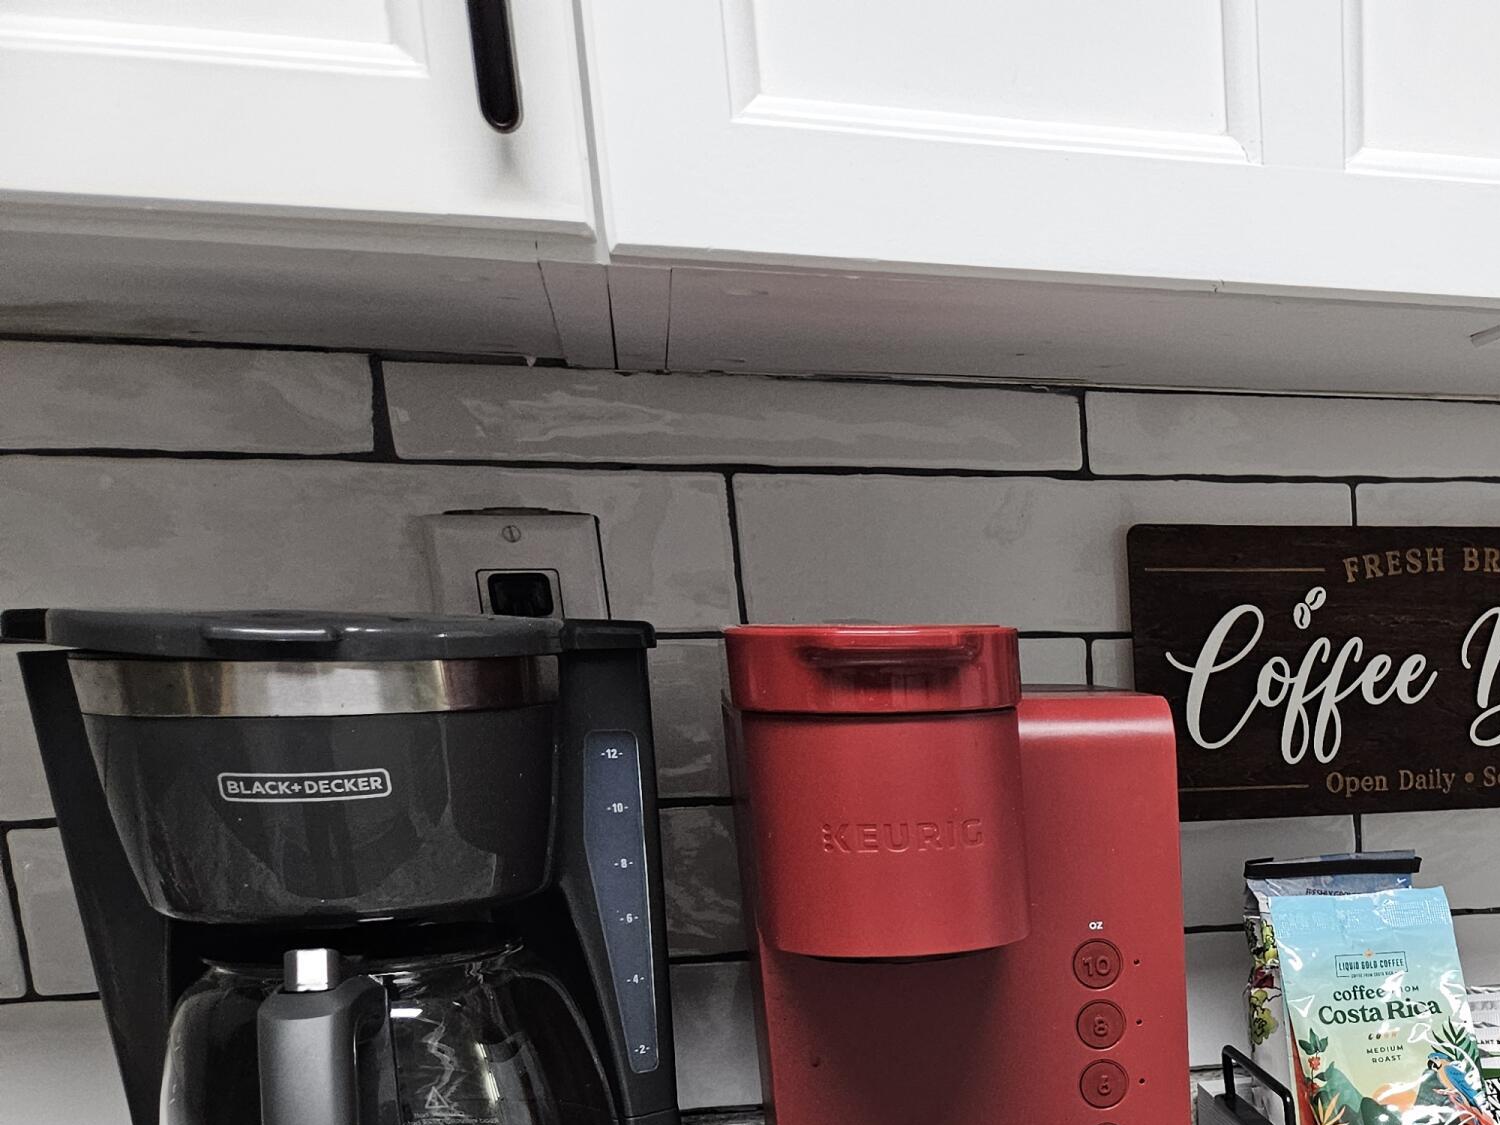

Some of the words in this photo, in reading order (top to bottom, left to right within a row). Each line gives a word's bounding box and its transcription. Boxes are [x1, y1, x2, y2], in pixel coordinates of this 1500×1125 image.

[1342, 547, 1446, 583] FRESH
[1165, 603, 1439, 765] Coffee
[226, 776, 384, 795] BLACK+DECKER
[1326, 771, 1389, 797] Open
[1399, 767, 1456, 794] Daily
[822, 818, 985, 853] KEURIG
[1082, 955, 1111, 977] 10
[1379, 958, 1405, 969] COFFEE
[1333, 984, 1385, 1002] coffee
[1318, 1003, 1384, 1025] Costa
[1385, 998, 1442, 1020] Rica
[1093, 1016, 1108, 1037] 8
[1366, 1045, 1404, 1054] MEDIUM
[1372, 1055, 1402, 1063] ROAST
